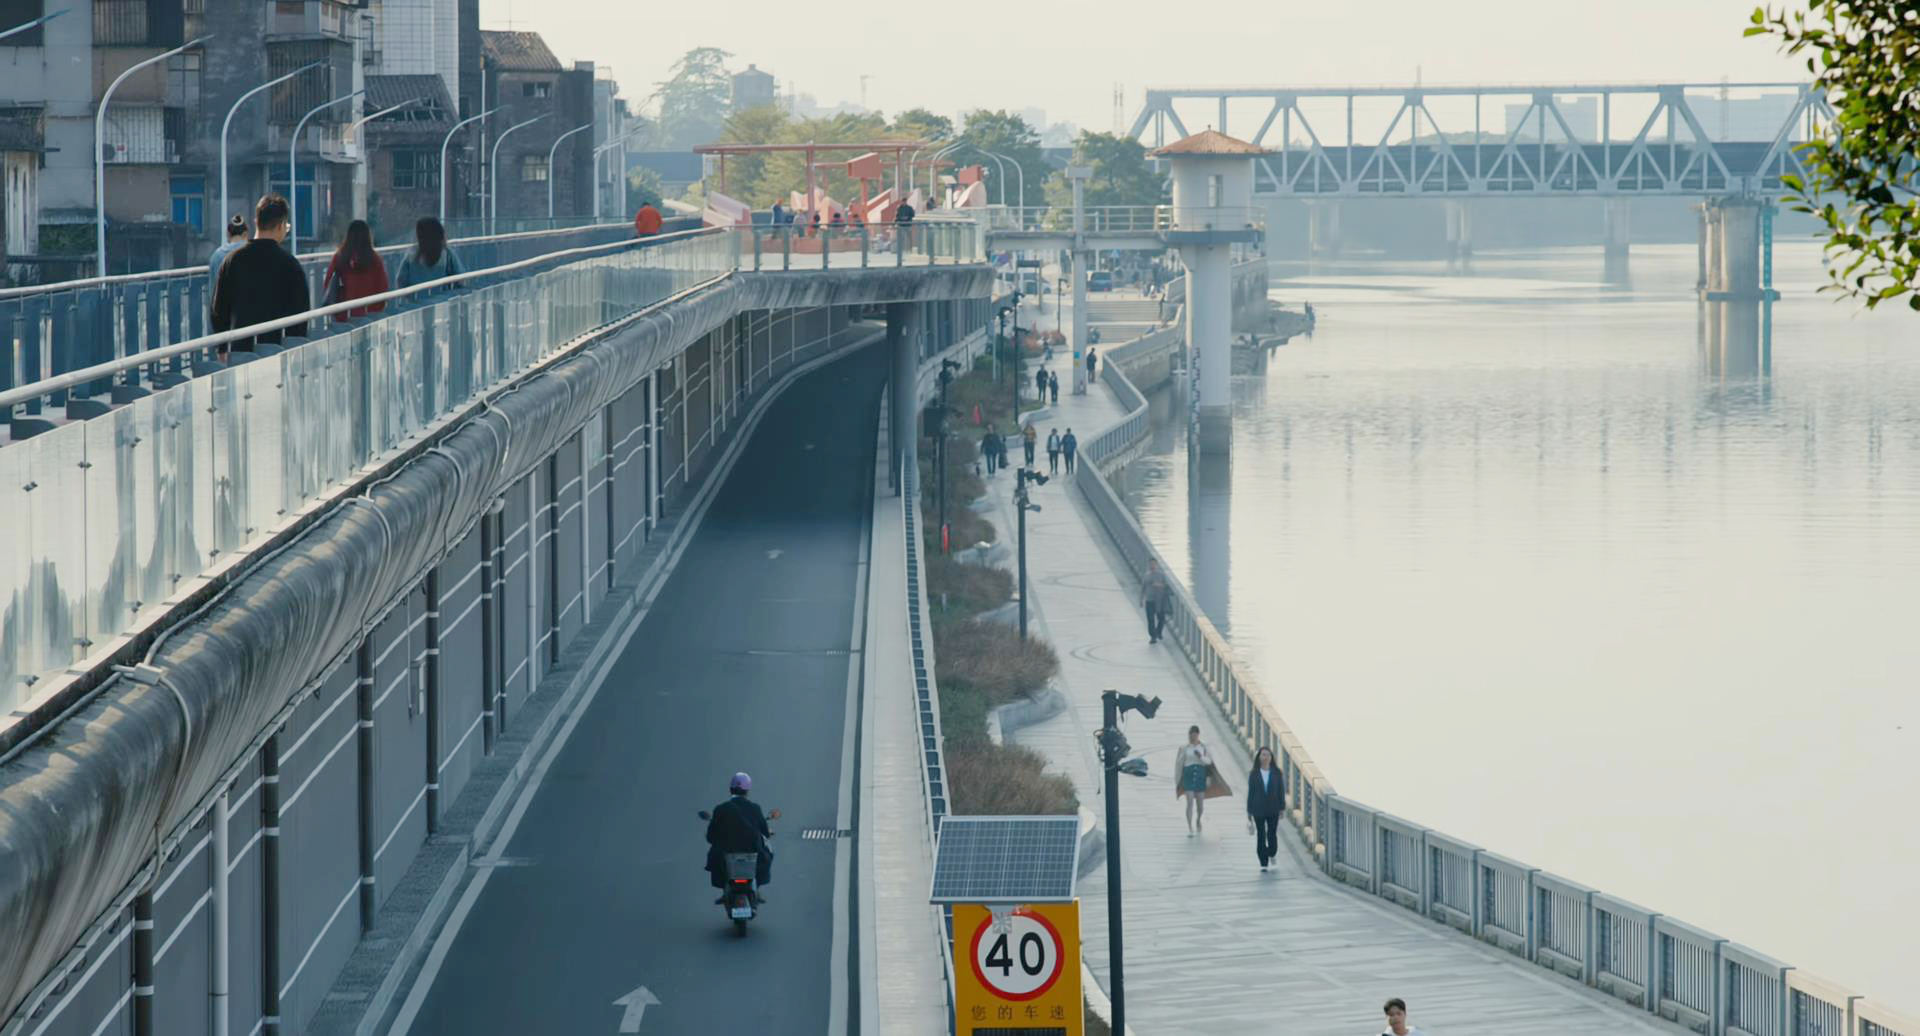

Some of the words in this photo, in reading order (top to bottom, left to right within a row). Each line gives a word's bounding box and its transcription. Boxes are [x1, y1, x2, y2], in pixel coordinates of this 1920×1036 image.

[985, 932, 1045, 976] 40
[972, 1006, 1064, 1020] 您的车速
